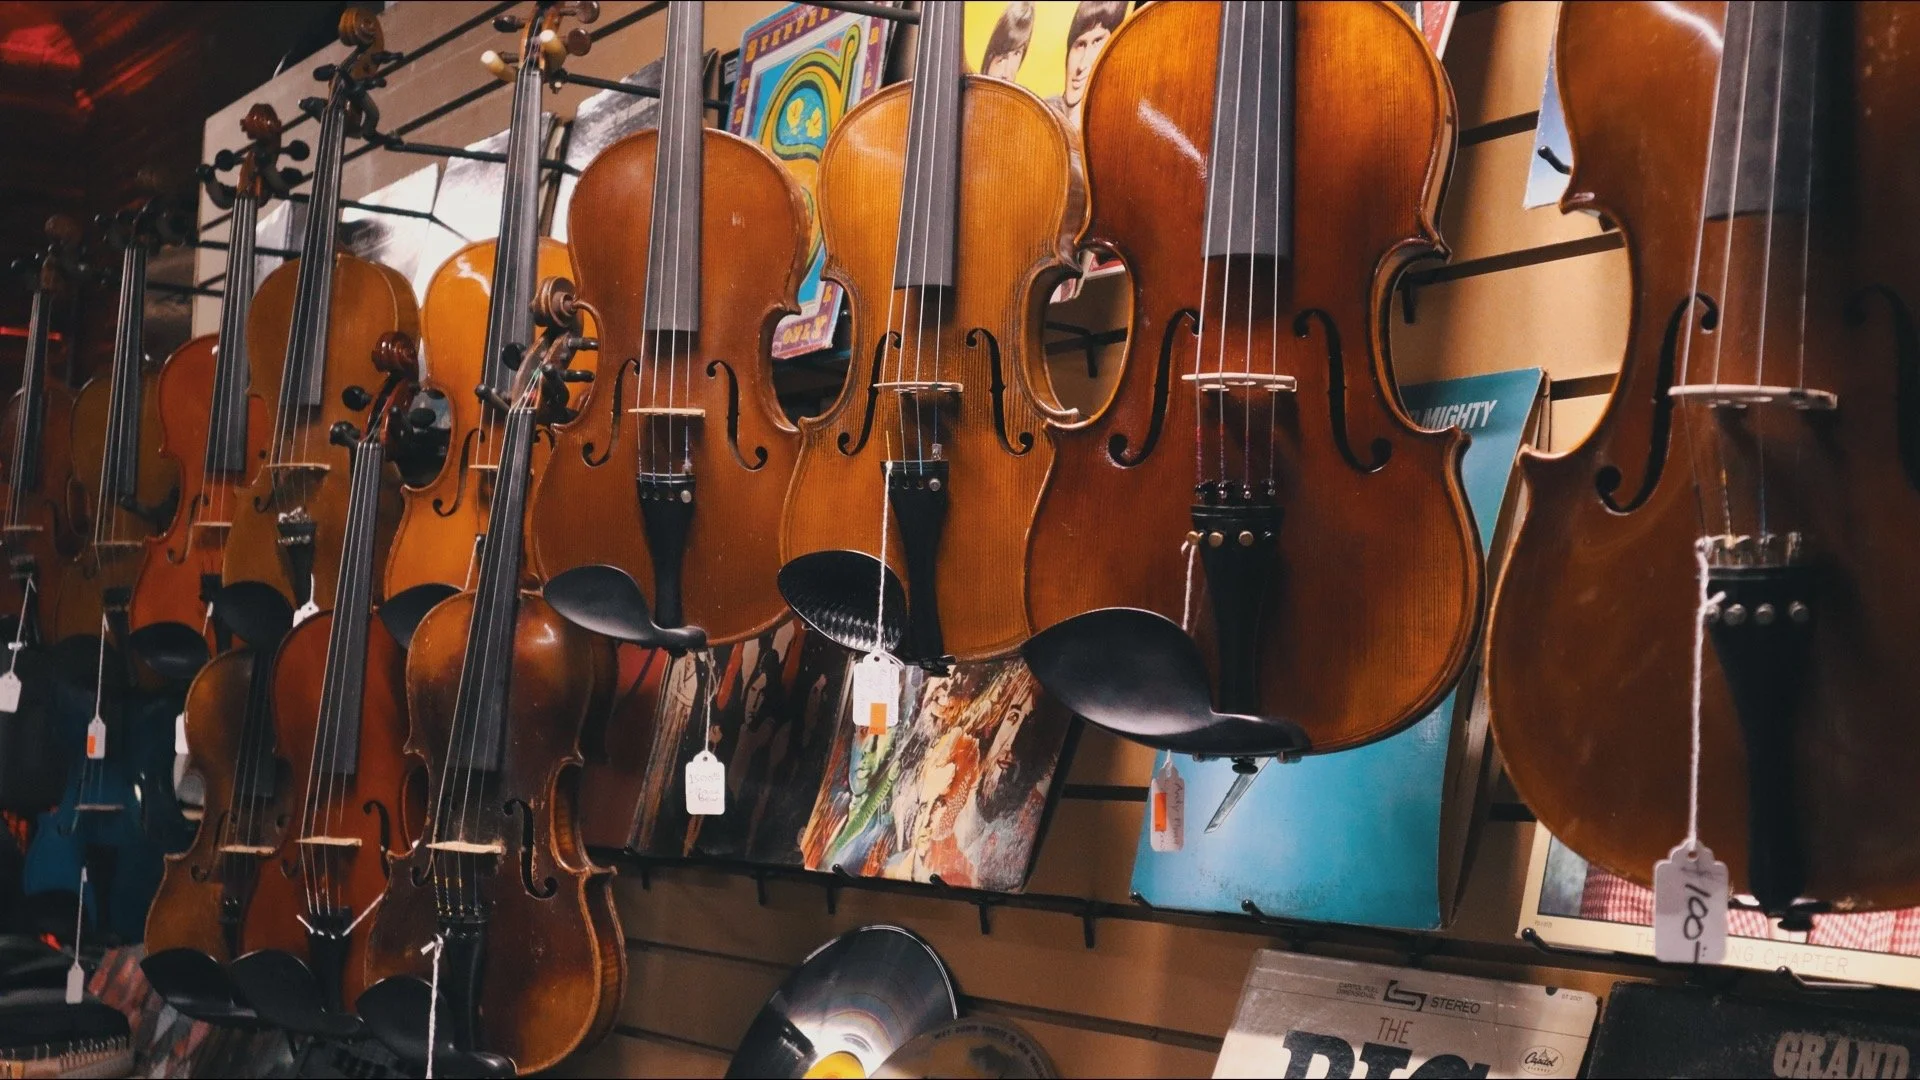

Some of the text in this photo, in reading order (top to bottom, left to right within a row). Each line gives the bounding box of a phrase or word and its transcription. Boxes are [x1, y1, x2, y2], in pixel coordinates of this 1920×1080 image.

[1422, 400, 1498, 429] MIGHTY
[1763, 948, 1849, 974] CHAPTER
[1430, 996, 1481, 1015] STEREO
[1376, 1017, 1414, 1044] THE
[1524, 1051, 1559, 1069] Capitol
[1773, 1031, 1910, 1079] GRAND
